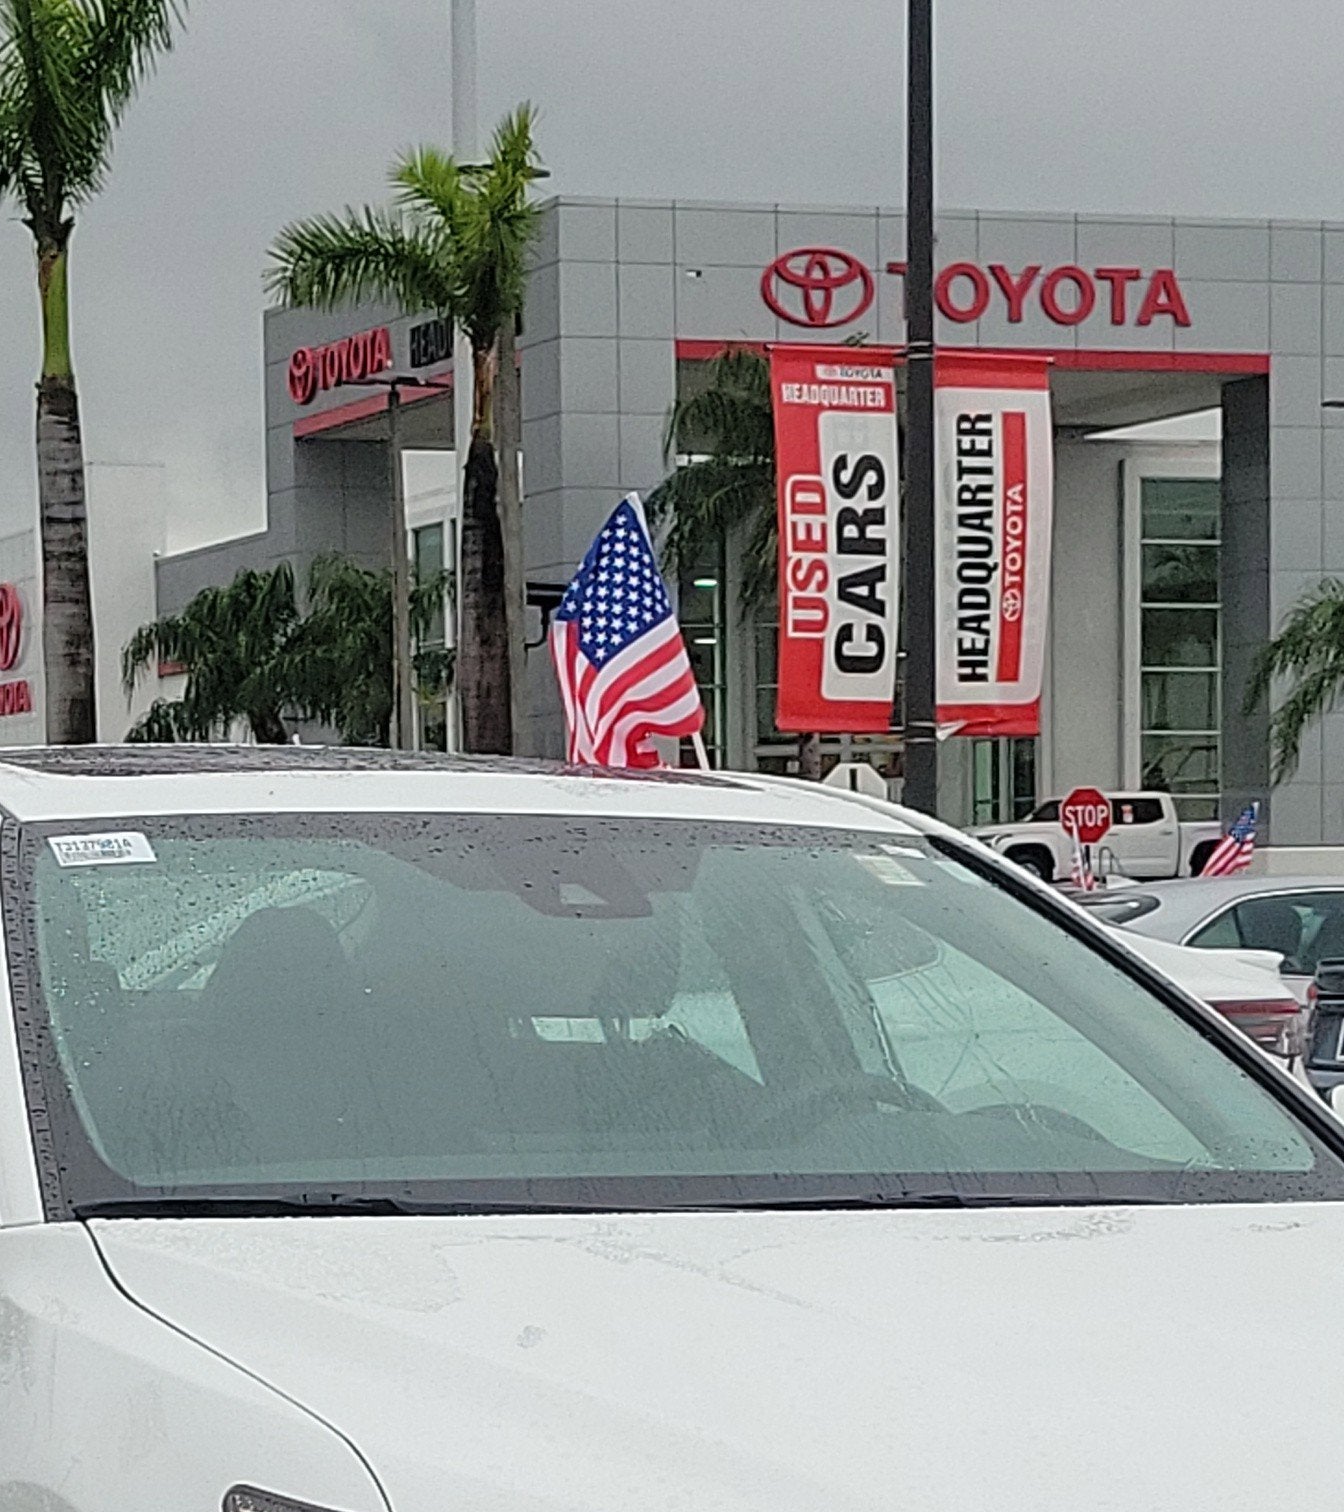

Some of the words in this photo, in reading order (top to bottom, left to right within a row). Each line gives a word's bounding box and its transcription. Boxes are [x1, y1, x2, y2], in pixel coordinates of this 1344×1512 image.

[314, 327, 392, 391] TOYOTA
[782, 383, 885, 407] HEADQUARTER
[786, 474, 831, 638] USED
[833, 453, 886, 673] CARS
[957, 413, 999, 682] HEADQUARTER
[1006, 482, 1024, 584] TOYOTA
[1065, 805, 1108, 827] STOP
